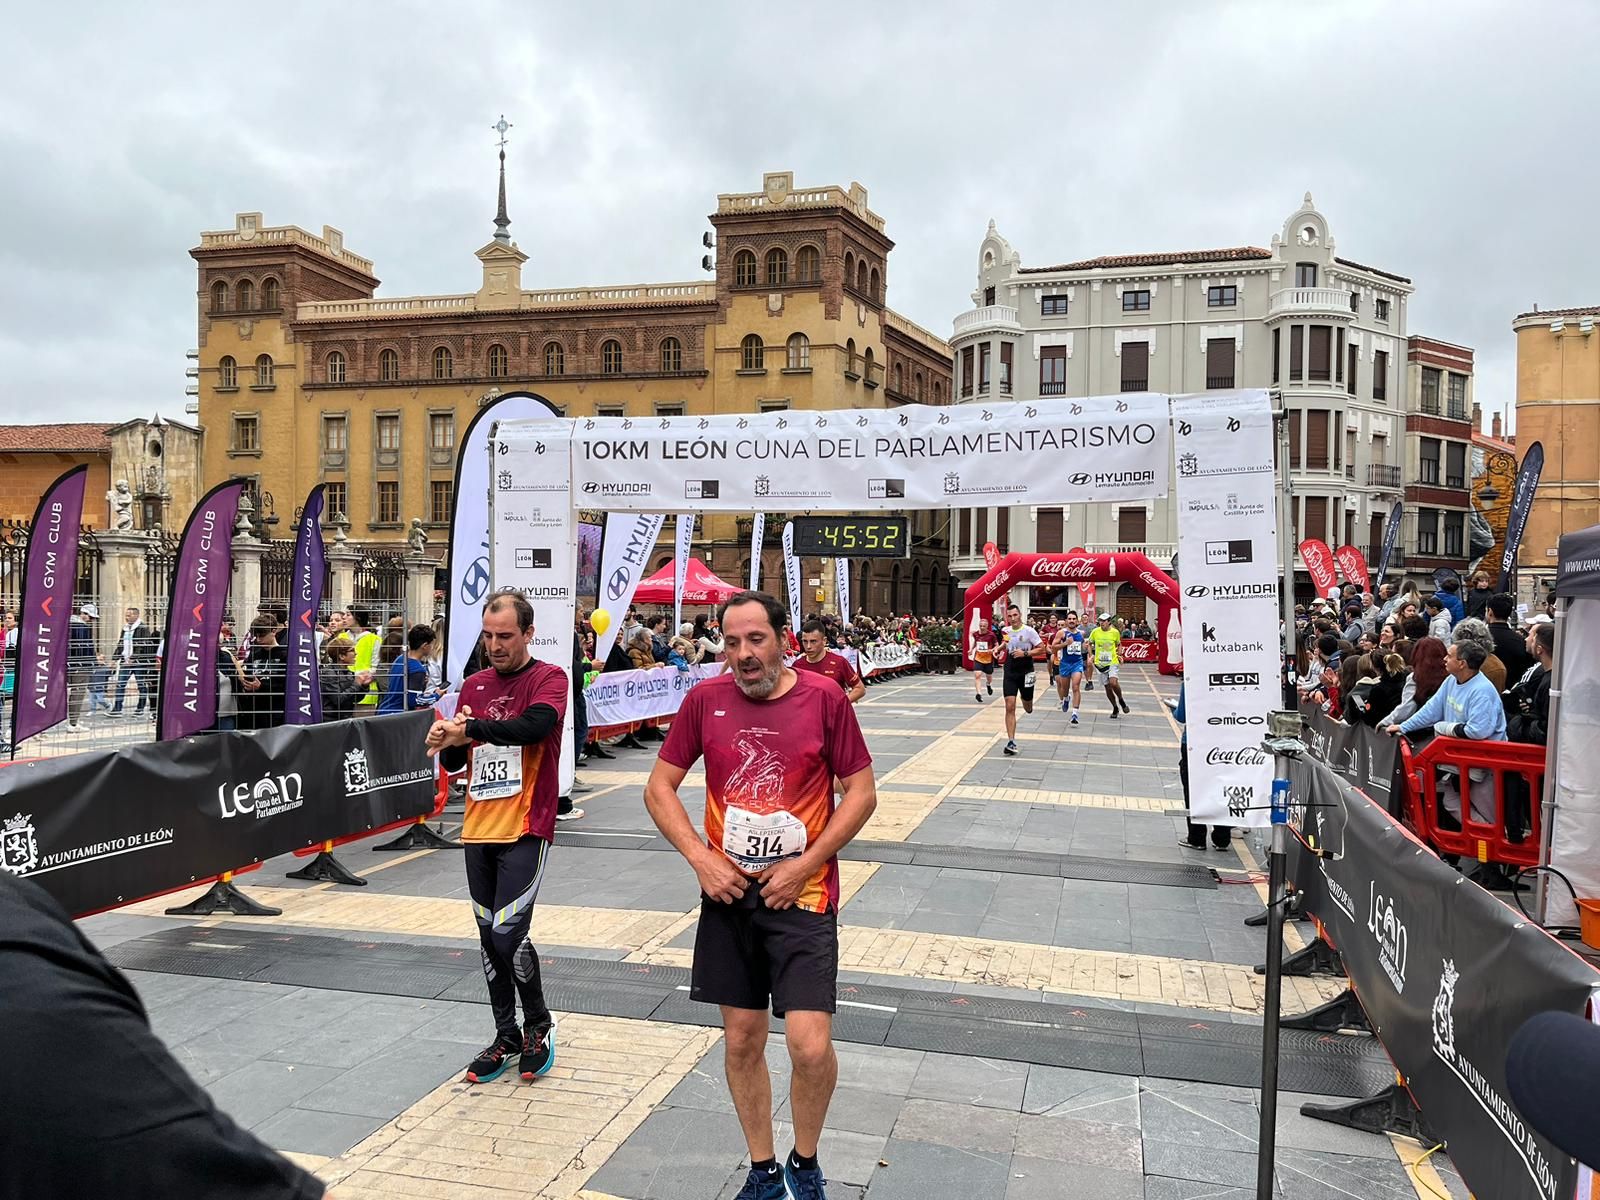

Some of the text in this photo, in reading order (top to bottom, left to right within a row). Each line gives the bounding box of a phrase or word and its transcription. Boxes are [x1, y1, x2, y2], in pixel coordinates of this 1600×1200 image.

[583, 423, 1155, 460] 10KM LEÓN CUNA DEL PARLAMENTARISMO
[1095, 470, 1154, 482] HYUNDAI
[1200, 466, 1246, 474] AYUNTAMIENTO
[601, 483, 651, 492] HYUNDAI
[1031, 558, 1098, 578] Coca-Cola
[302, 564, 312, 601] GYM
[1213, 584, 1276, 596] HYUNDAI
[35, 502, 63, 709] ALTAFIT GYM CLUB
[184, 510, 216, 712] ALTAFIT GYM CLUB
[1202, 642, 1264, 653] kutxabank
[298, 634, 312, 716] ALTAFIT
[638, 679, 668, 694] HYUNDAI
[1208, 712, 1264, 726] emico
[410, 771, 418, 780] DE
[418, 768, 432, 778] LEÓN
[480, 760, 508, 782] 433
[255, 794, 280, 809] Cuna del
[256, 800, 304, 819] Parlamentarismo
[41, 828, 174, 868] AYUNTAMIENTO DE LEÓN
[746, 836, 783, 856] 314
[1458, 1054, 1558, 1200] AYUNTAMIENTO DE LEÓN
